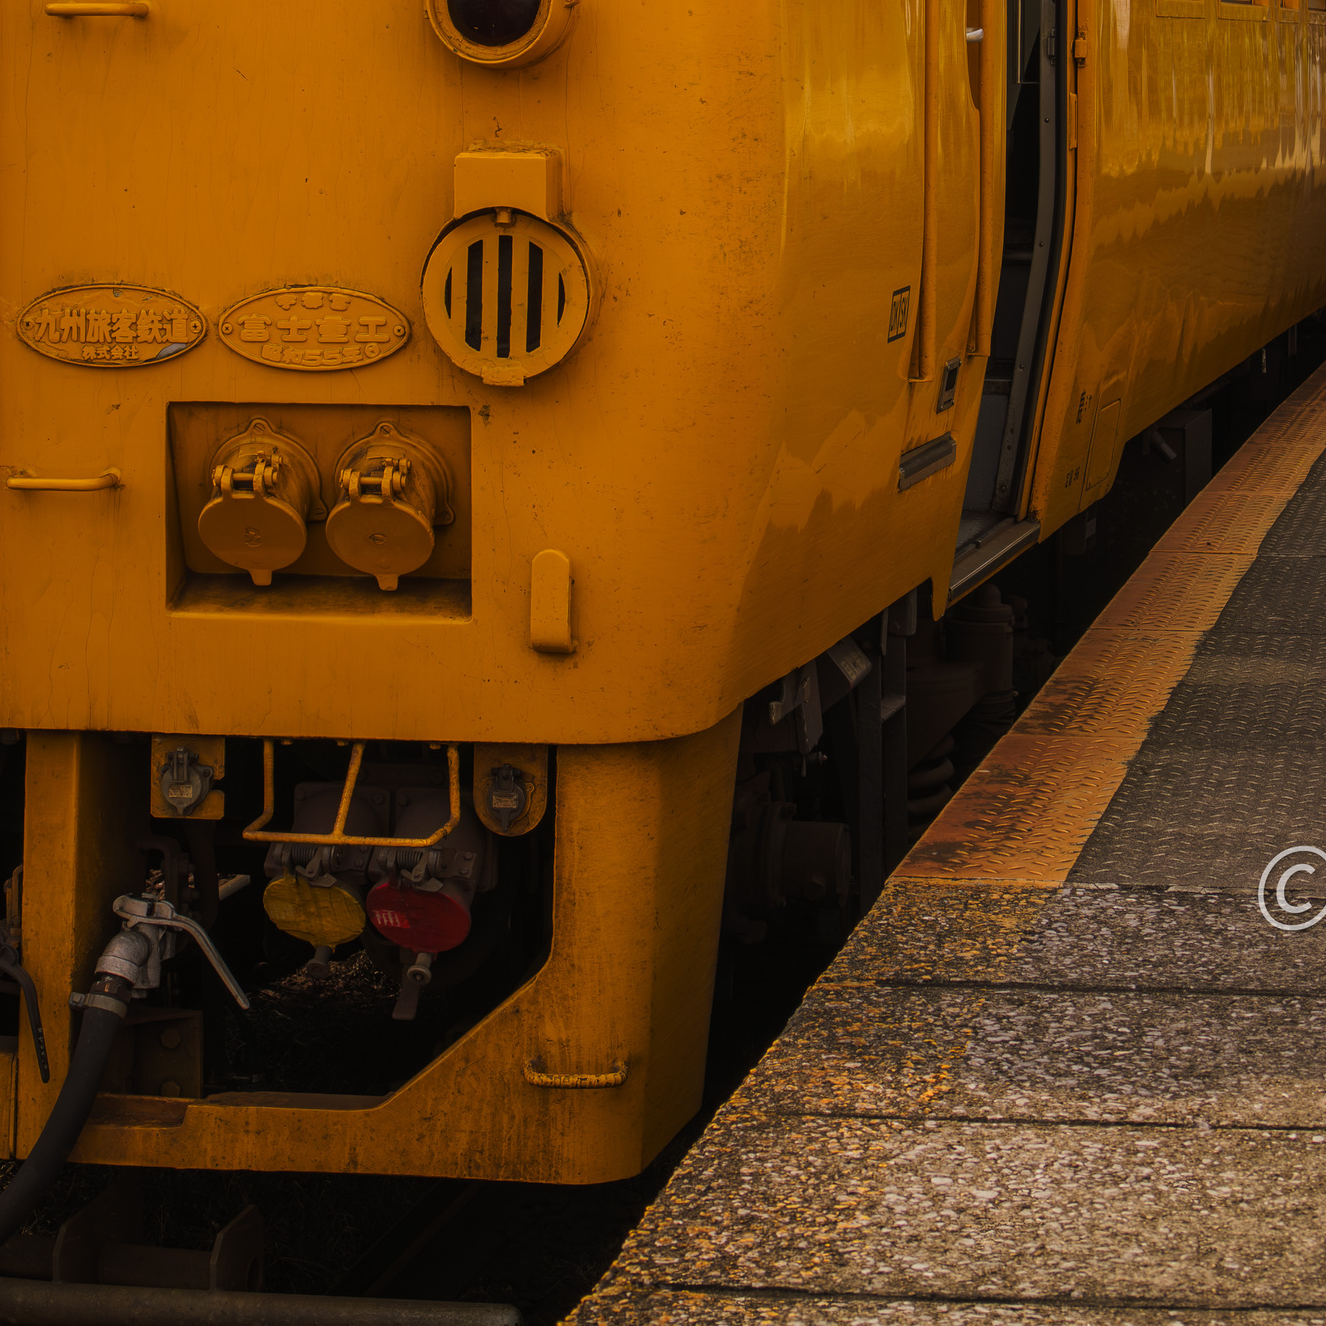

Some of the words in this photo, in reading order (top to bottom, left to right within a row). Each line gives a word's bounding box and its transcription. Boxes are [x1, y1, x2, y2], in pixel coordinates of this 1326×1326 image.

[237, 313, 391, 343] 富士重工
[82, 345, 139, 360] 株式会社
